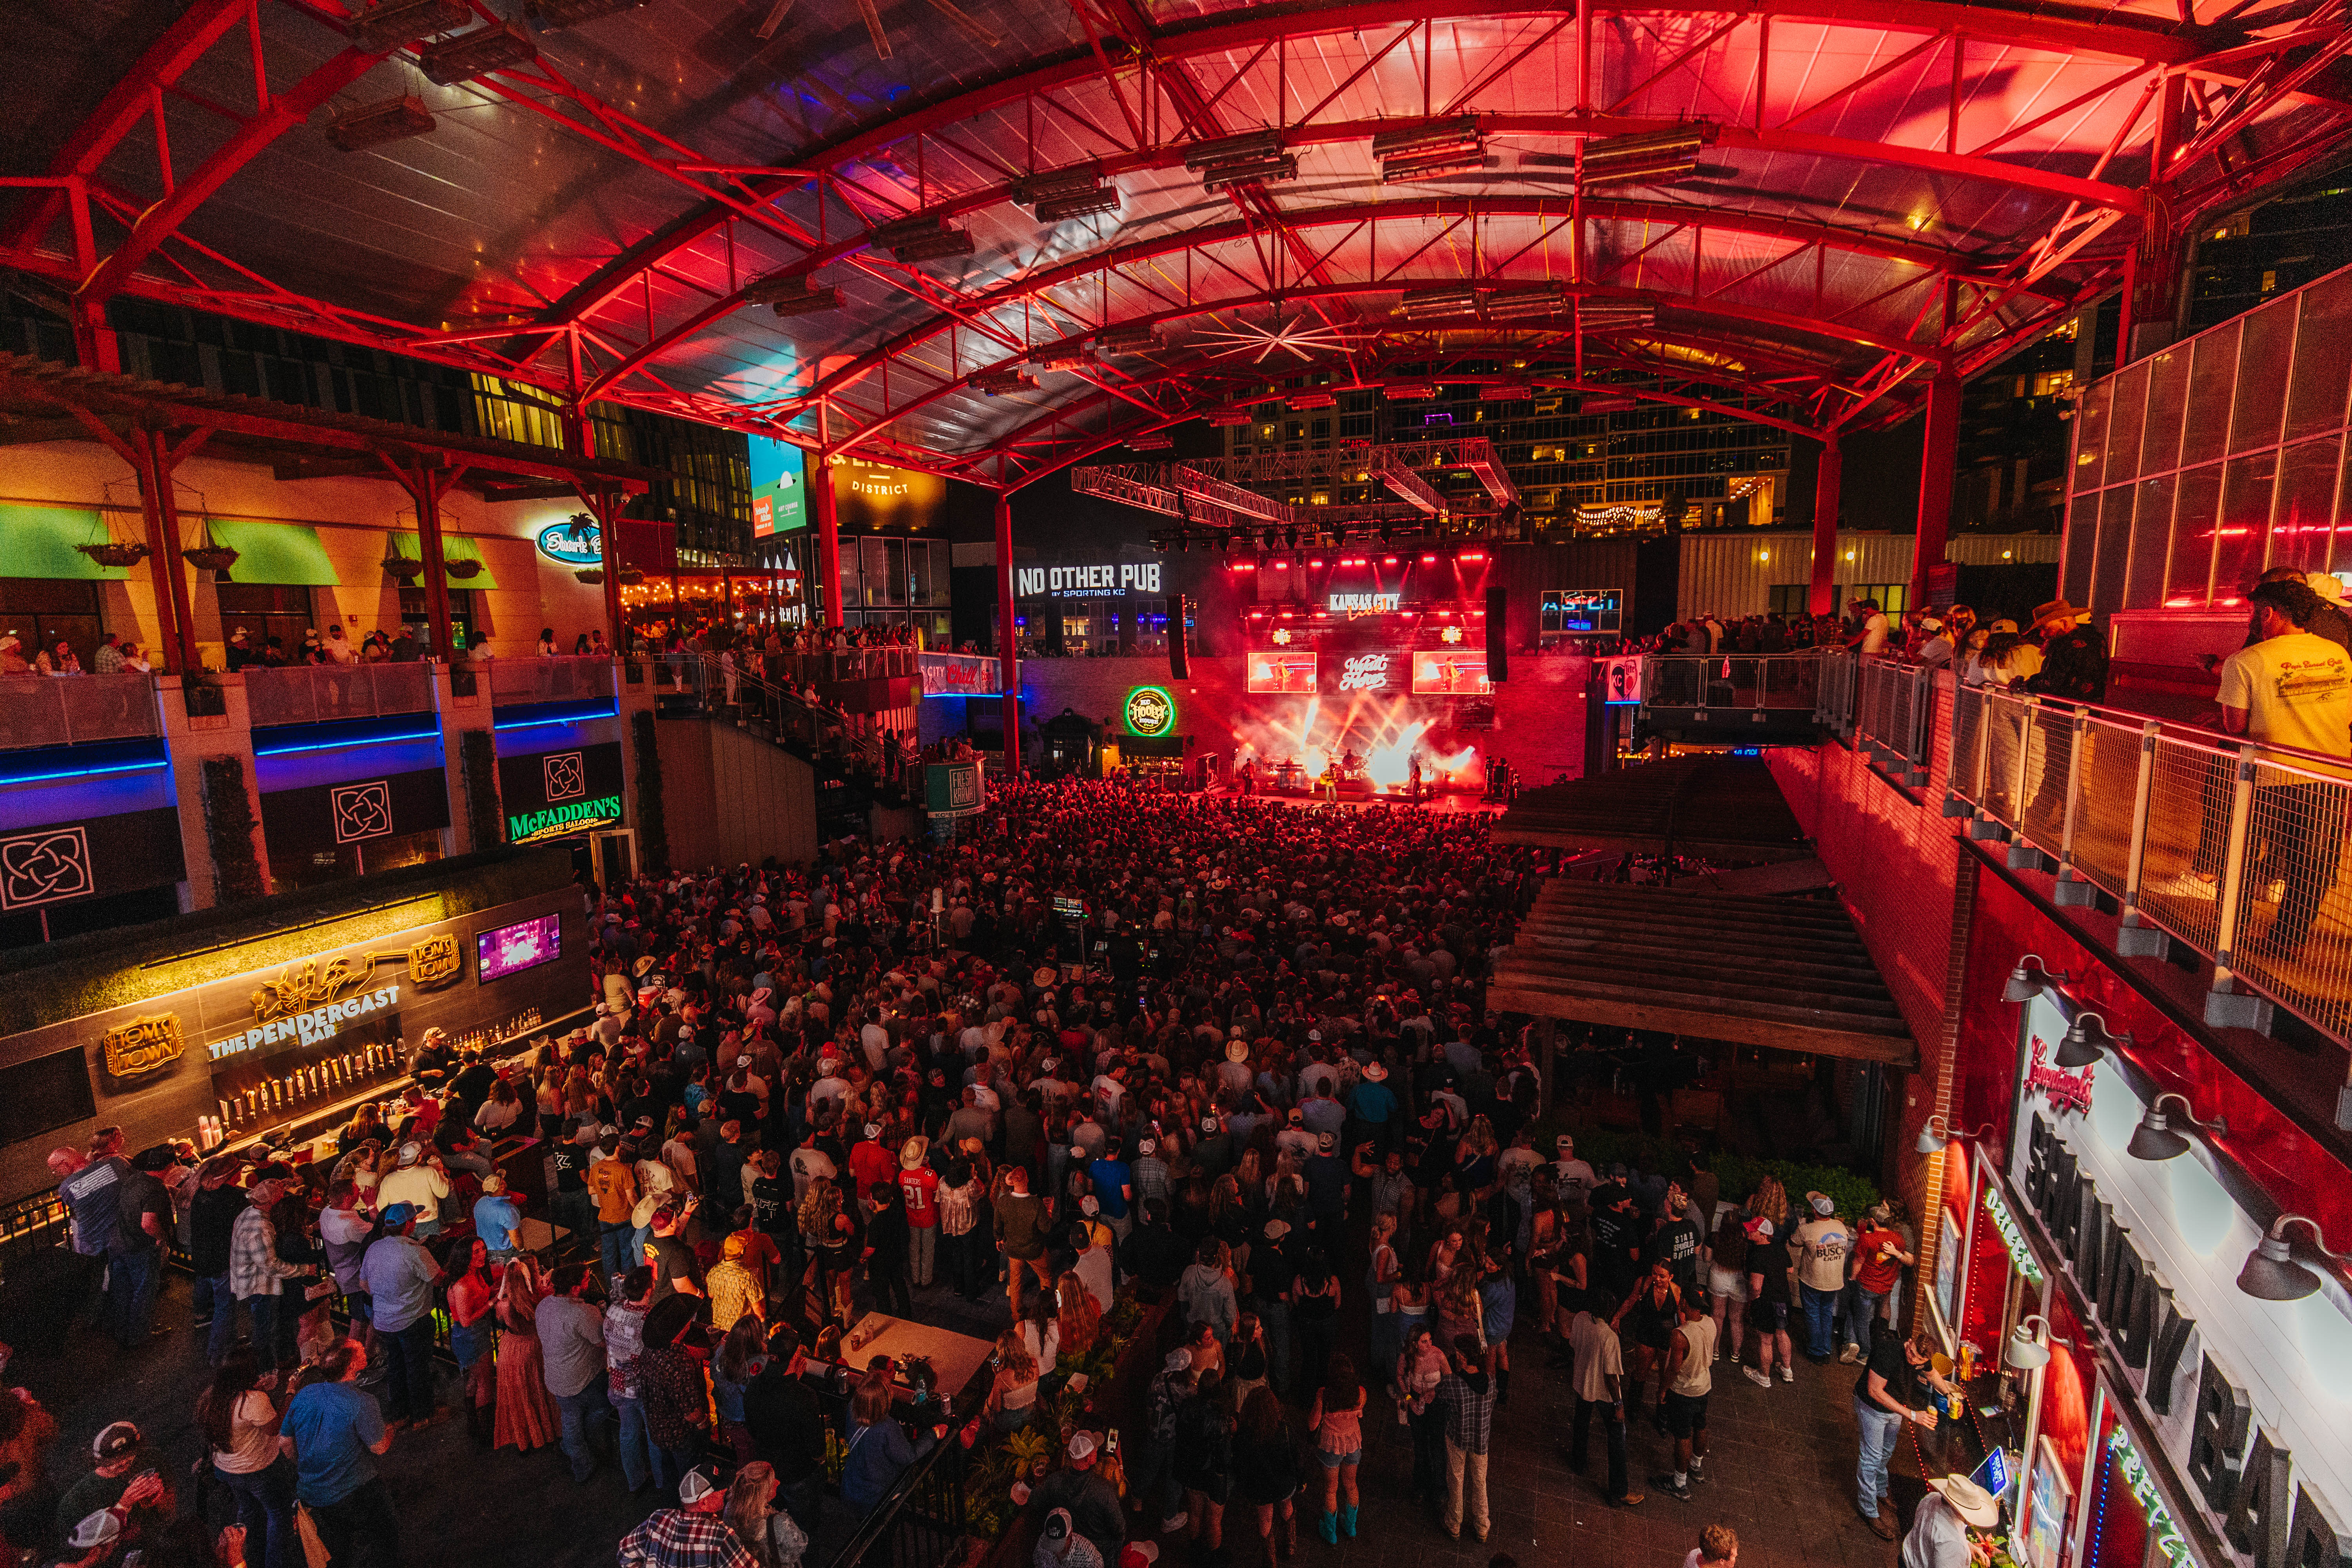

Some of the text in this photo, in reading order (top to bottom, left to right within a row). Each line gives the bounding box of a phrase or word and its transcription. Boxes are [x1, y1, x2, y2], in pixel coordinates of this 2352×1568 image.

[852, 481, 908, 495] DISTRICT
[546, 531, 588, 554] Shark
[1019, 563, 1160, 597] NO OTHER PUB
[1063, 589, 1111, 597] SPORTING
[1330, 593, 1400, 610] KANSAS CITY
[1347, 599, 1387, 621] Live!
[927, 666, 945, 678] CITY
[947, 663, 978, 685] Chill
[1344, 654, 1389, 676] Wyatt
[1339, 671, 1387, 691] Flores
[1612, 674, 1622, 687] KC
[1132, 703, 1168, 721] HOOLEY
[953, 771, 974, 787] FRESH
[953, 786, 974, 802] KARMA
[510, 795, 621, 841] McFADDEN'S
[955, 807, 982, 816] FAVORITE
[418, 940, 451, 961] TOM'S
[418, 956, 453, 978] TOWN
[209, 985, 399, 1059] THE PENDERGAST
[117, 1019, 169, 1046] TOM'S
[301, 1022, 336, 1047] BAR
[119, 1042, 172, 1069] TOWN
[904, 1177, 921, 1185] SANDERS
[756, 1198, 779, 1211] UFC
[903, 1185, 926, 1209] 21
[1675, 1232, 1693, 1243] STAR
[1817, 1245, 1846, 1258] BUSCH
[2025, 1110, 2196, 1416] SHANDY
